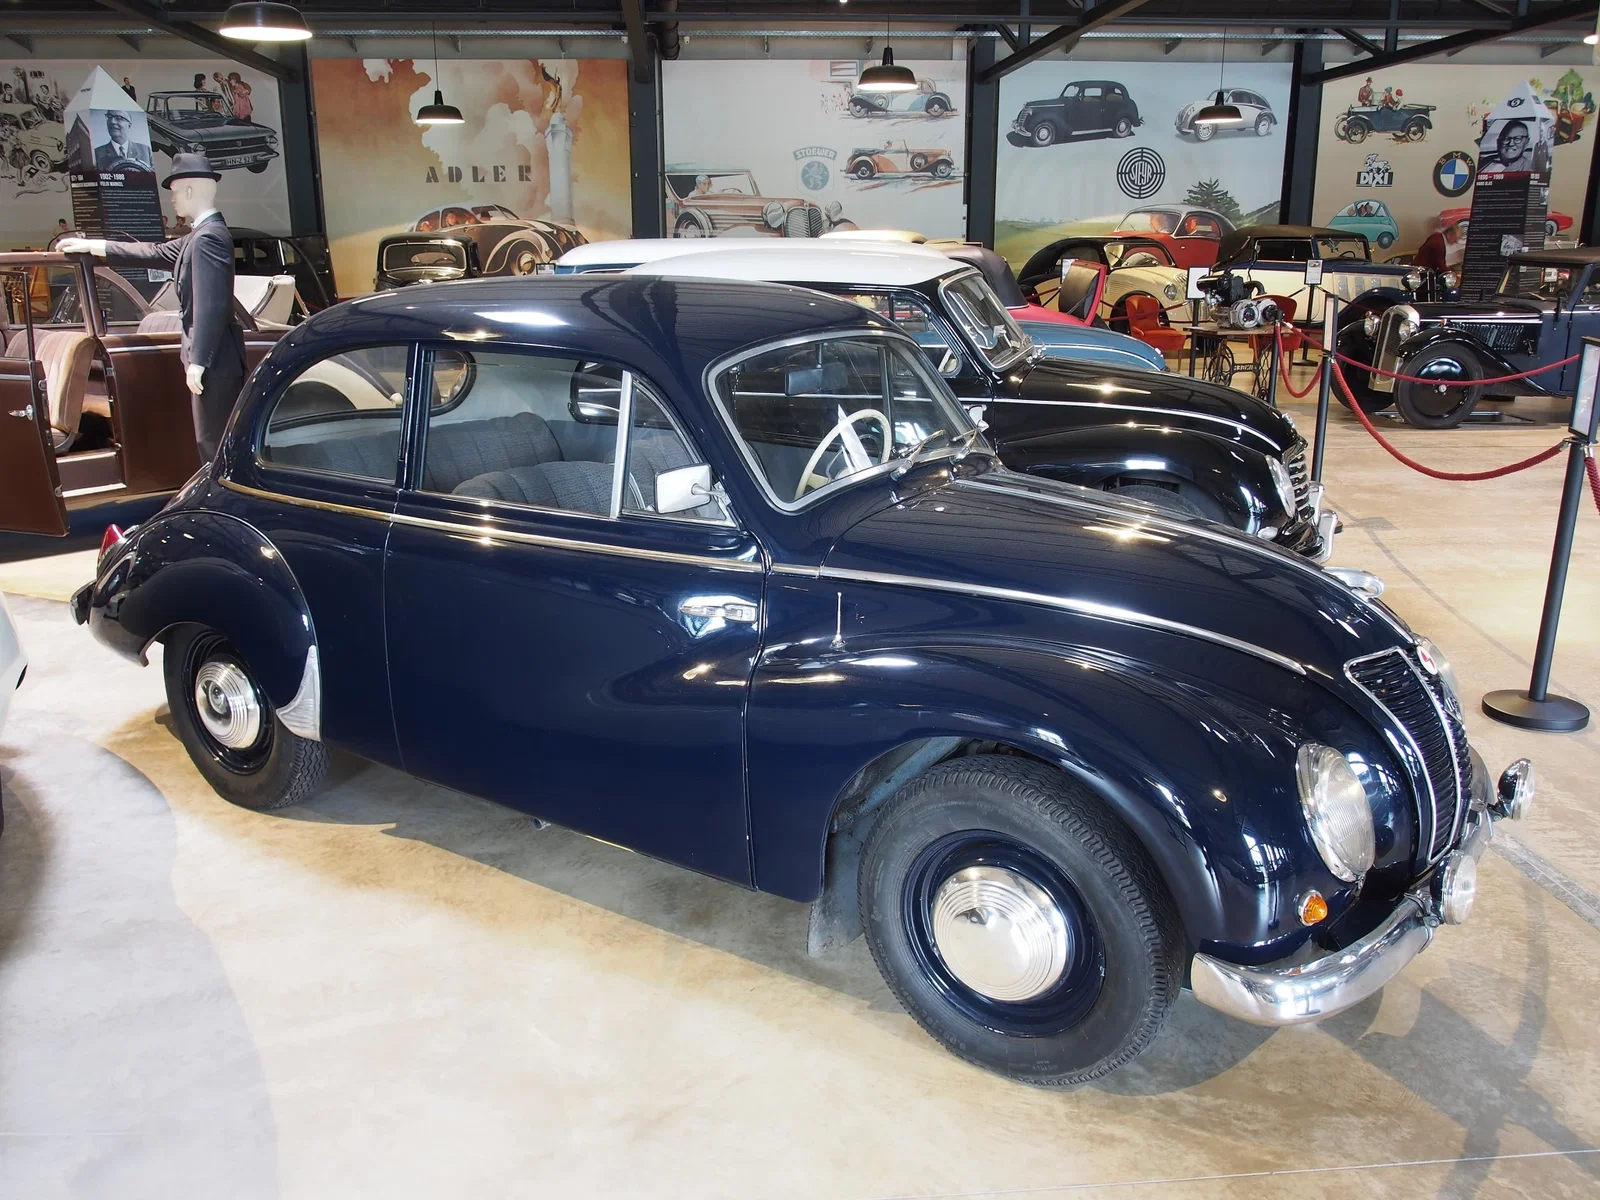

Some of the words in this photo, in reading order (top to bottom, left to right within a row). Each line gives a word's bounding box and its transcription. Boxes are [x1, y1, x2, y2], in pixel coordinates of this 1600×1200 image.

[795, 147, 836, 159] STOEWER
[1438, 152, 1474, 167] BMW
[425, 164, 533, 184] ADLER
[1129, 161, 1153, 186] STEYR
[1359, 172, 1389, 188] DIXI
